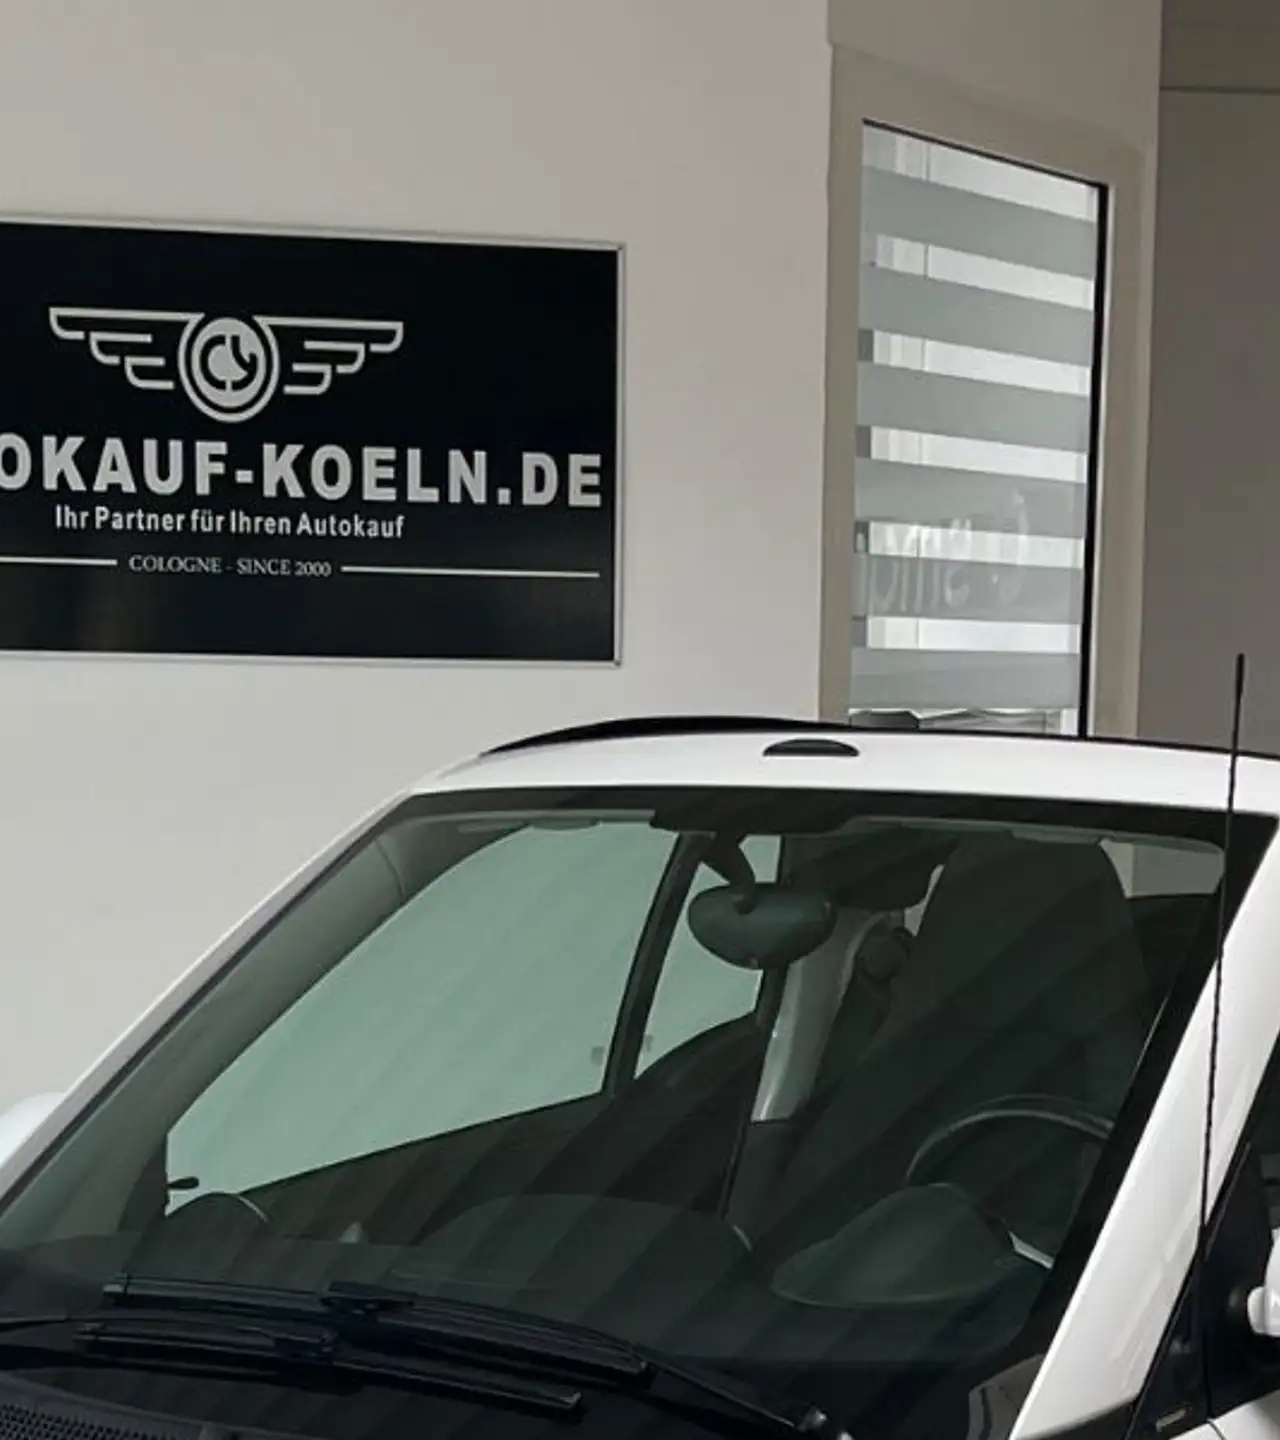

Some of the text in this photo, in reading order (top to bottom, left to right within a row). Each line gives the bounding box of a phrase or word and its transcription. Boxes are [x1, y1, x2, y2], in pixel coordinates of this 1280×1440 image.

[55, 503, 406, 539] Ihr Partner für Ihren Autokauf
[128, 554, 224, 574] COLOGNE
[236, 557, 291, 577] SINCE
[294, 560, 333, 578] 2000
